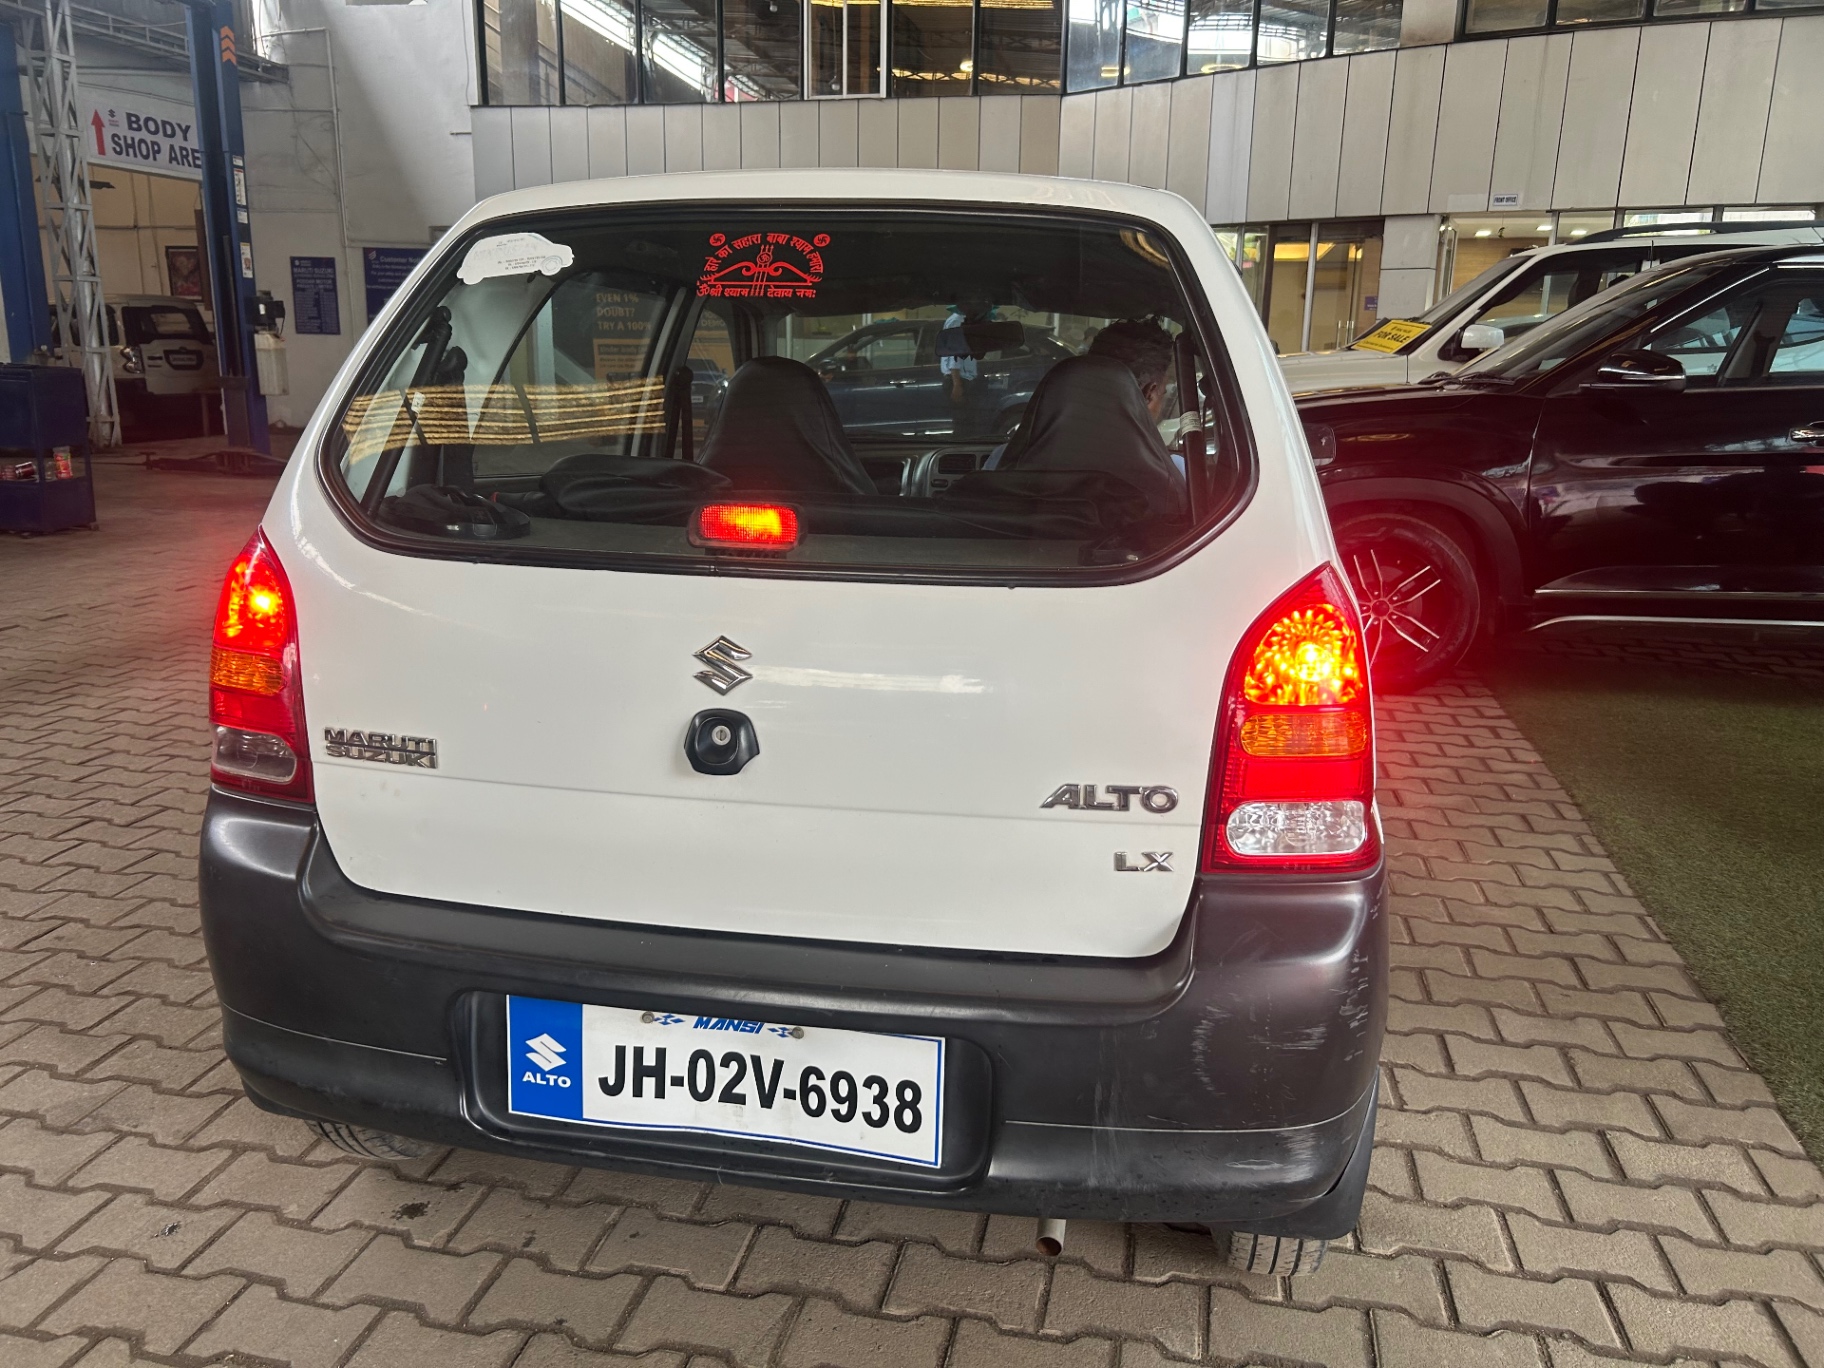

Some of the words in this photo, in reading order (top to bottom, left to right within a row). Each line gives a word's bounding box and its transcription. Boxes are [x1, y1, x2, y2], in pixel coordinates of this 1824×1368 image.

[125, 112, 191, 142] BODY
[111, 133, 161, 161] SHOP
[731, 233, 762, 251] सहारा
[766, 232, 791, 245] बाबा
[596, 293, 622, 303] EVEN
[623, 293, 639, 304] 1%
[596, 307, 636, 318] DOUBT?
[598, 321, 615, 331] TRY
[617, 321, 625, 331] A
[626, 321, 652, 331] 100%
[1374, 330, 1391, 341] FOR
[1388, 332, 1410, 344] SALE
[324, 728, 437, 755] MARUTI
[326, 743, 437, 769] SUZUKI
[1039, 783, 1179, 814] ALTO
[1114, 851, 1174, 872] LX
[693, 1015, 766, 1035] MANSI
[522, 1071, 572, 1088] ALTO
[598, 1044, 923, 1134] JH-02V-6938
